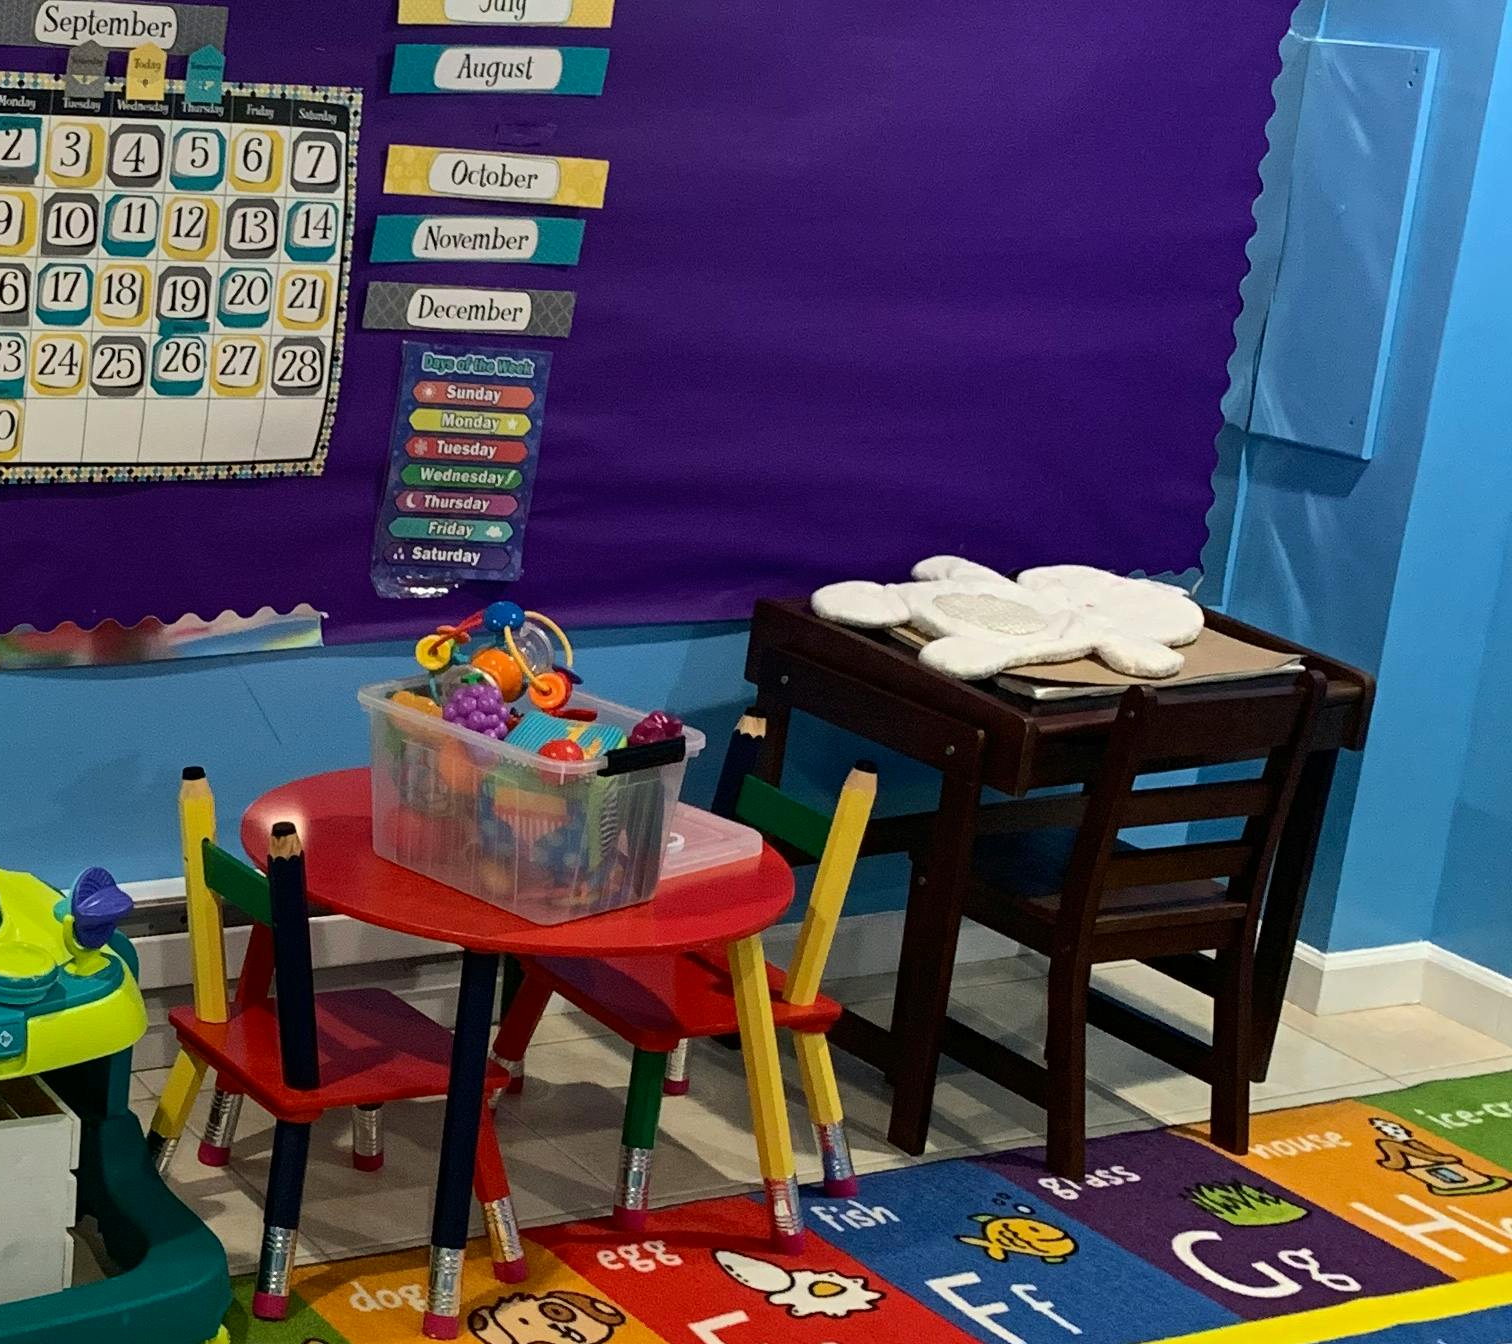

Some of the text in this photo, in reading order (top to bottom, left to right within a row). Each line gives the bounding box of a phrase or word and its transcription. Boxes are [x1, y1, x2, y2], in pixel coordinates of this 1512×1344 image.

[43, 5, 173, 43] September
[133, 58, 161, 72] Today
[457, 53, 535, 87] August
[62, 97, 101, 113] Tuesday
[117, 98, 169, 115] Wednesday
[181, 103, 224, 118] Thursday
[246, 104, 275, 120] Friday
[298, 109, 338, 125] Saturday
[61, 131, 209, 169] 3 5
[451, 160, 539, 189] October
[52, 204, 89, 239] 10
[423, 226, 529, 251] November
[228, 273, 269, 305] 20
[418, 295, 523, 322] December
[99, 348, 135, 379] 25
[423, 354, 534, 376] Days of the Week
[446, 385, 502, 404] Sunday
[441, 412, 501, 432] Monday
[437, 440, 497, 459] Tuesday
[420, 467, 504, 485] Wednesday
[423, 494, 490, 512] Thursday
[428, 522, 474, 539] Friday
[412, 547, 481, 565] Saturday
[810, 1200, 901, 1232] fish
[596, 1239, 684, 1273] egg
